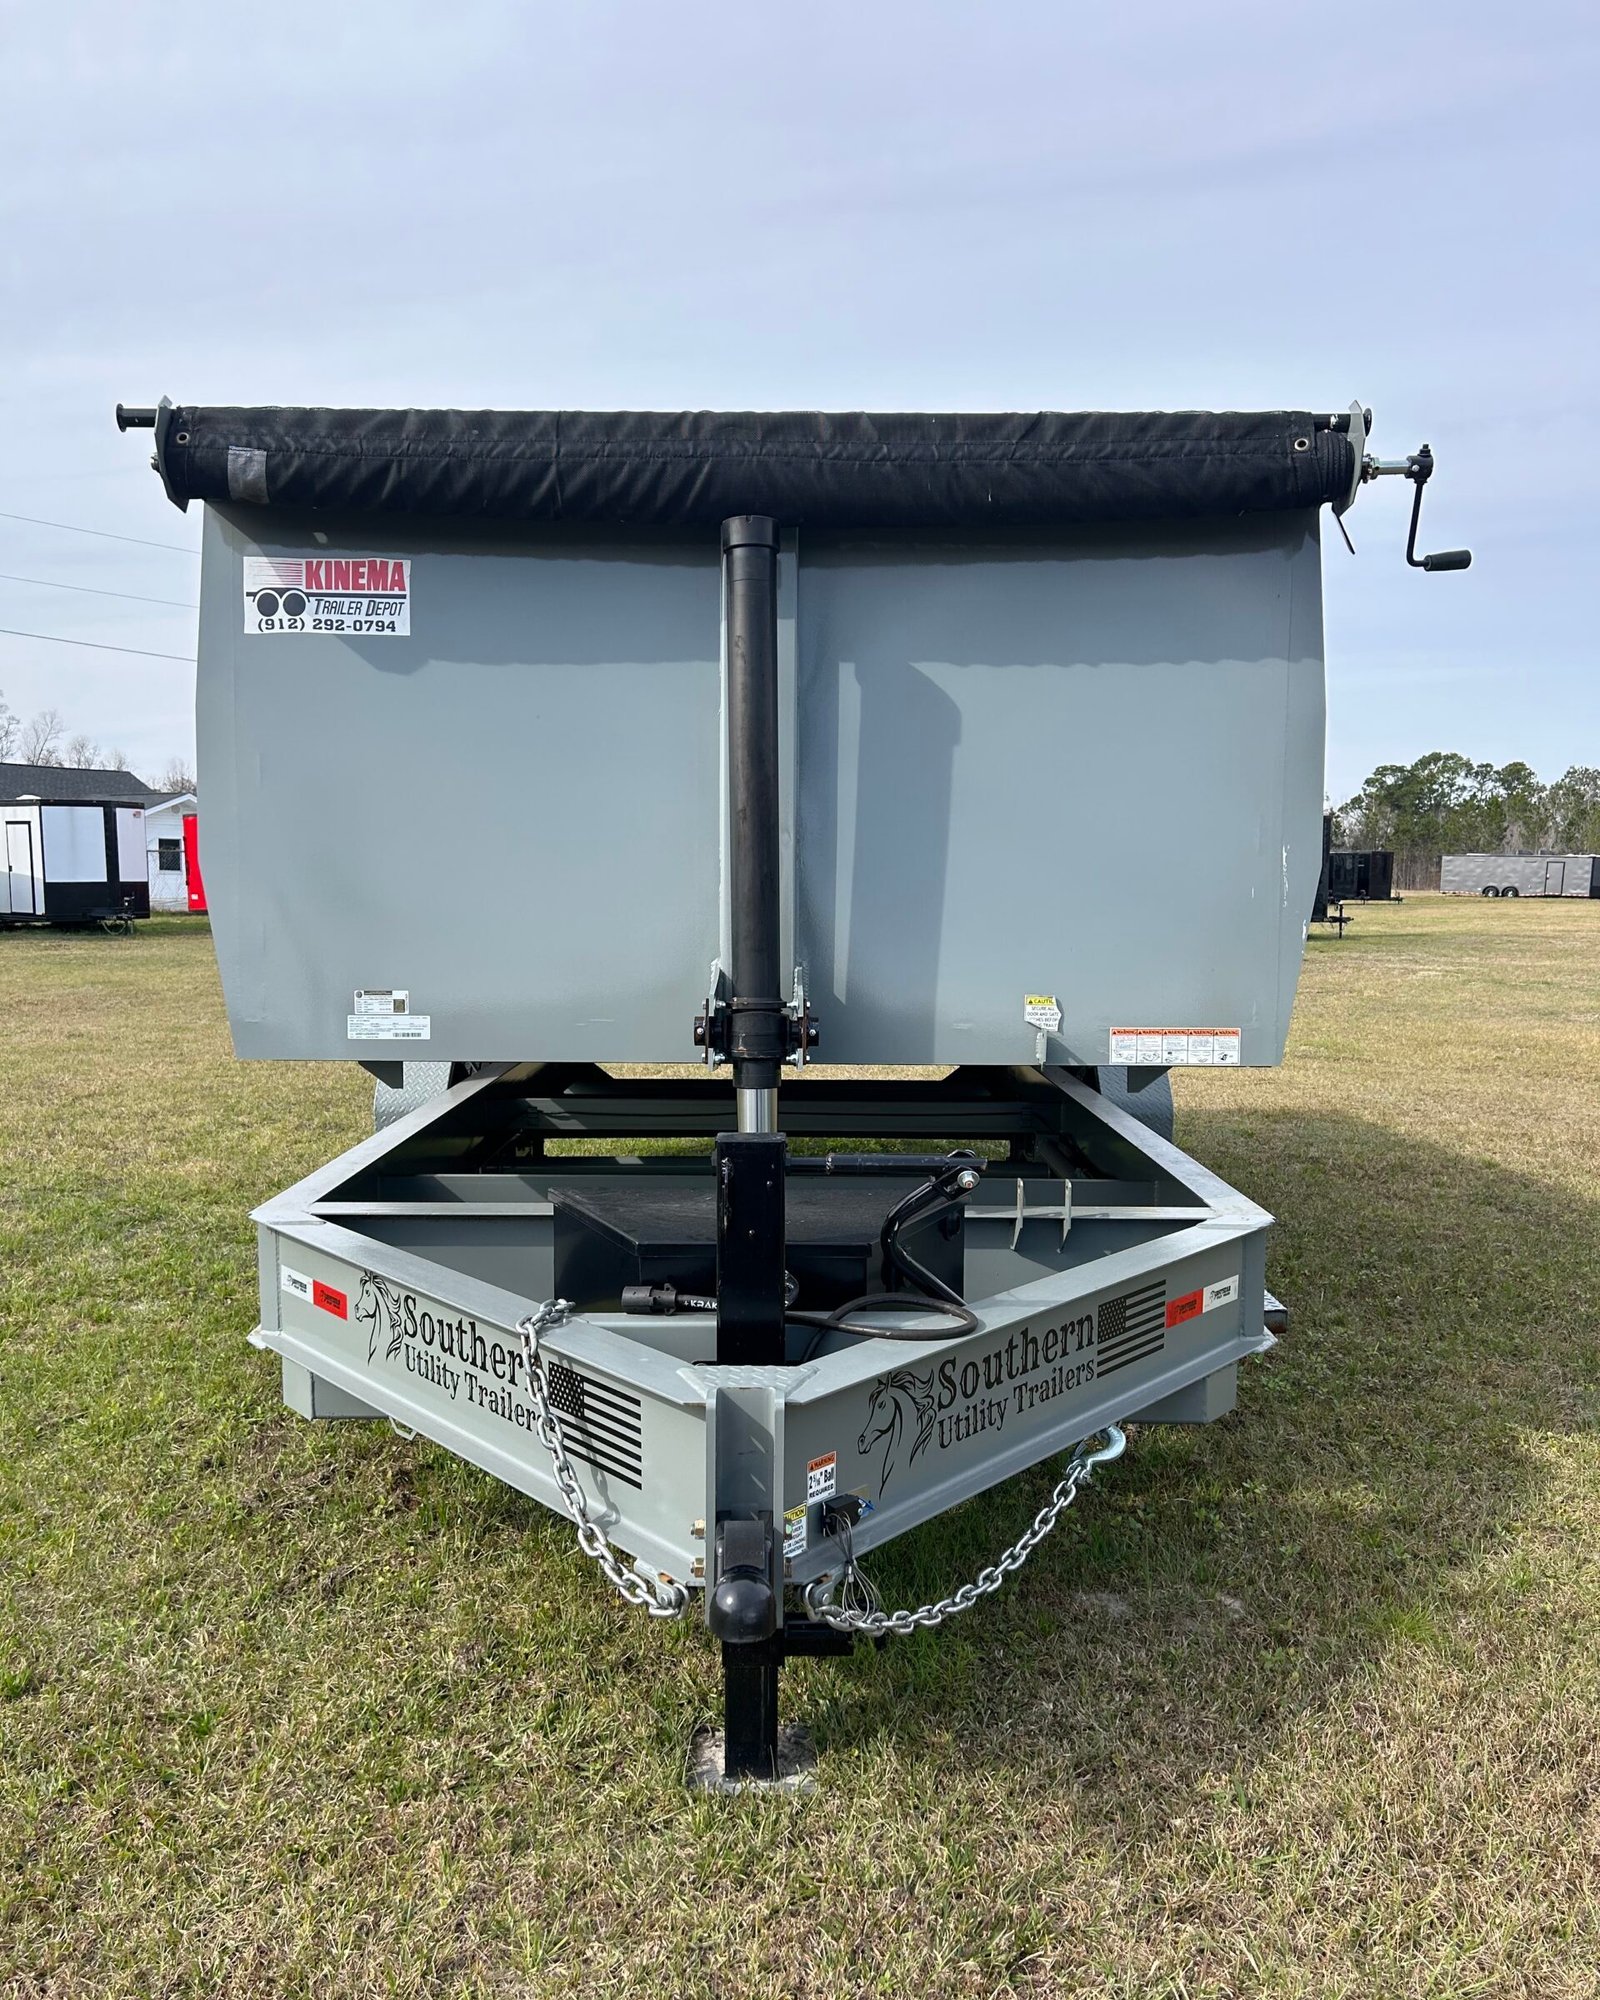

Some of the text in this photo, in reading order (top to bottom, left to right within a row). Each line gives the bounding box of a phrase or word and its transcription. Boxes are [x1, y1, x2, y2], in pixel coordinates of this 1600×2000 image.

[305, 559, 406, 592] KINEMA
[314, 598, 405, 617] TRAILER DEPOT
[258, 618, 396, 632] (912) 292-0794
[690, 1300, 718, 1309] KRAK
[404, 1294, 531, 1392] Souther
[404, 1343, 460, 1400] Utility
[937, 1313, 1095, 1411] Southern
[937, 1359, 1095, 1449] Utility Trailers
[813, 1455, 835, 1468] WARNING
[824, 1467, 834, 1483] Ball
[809, 1483, 834, 1498] REQUIRED
